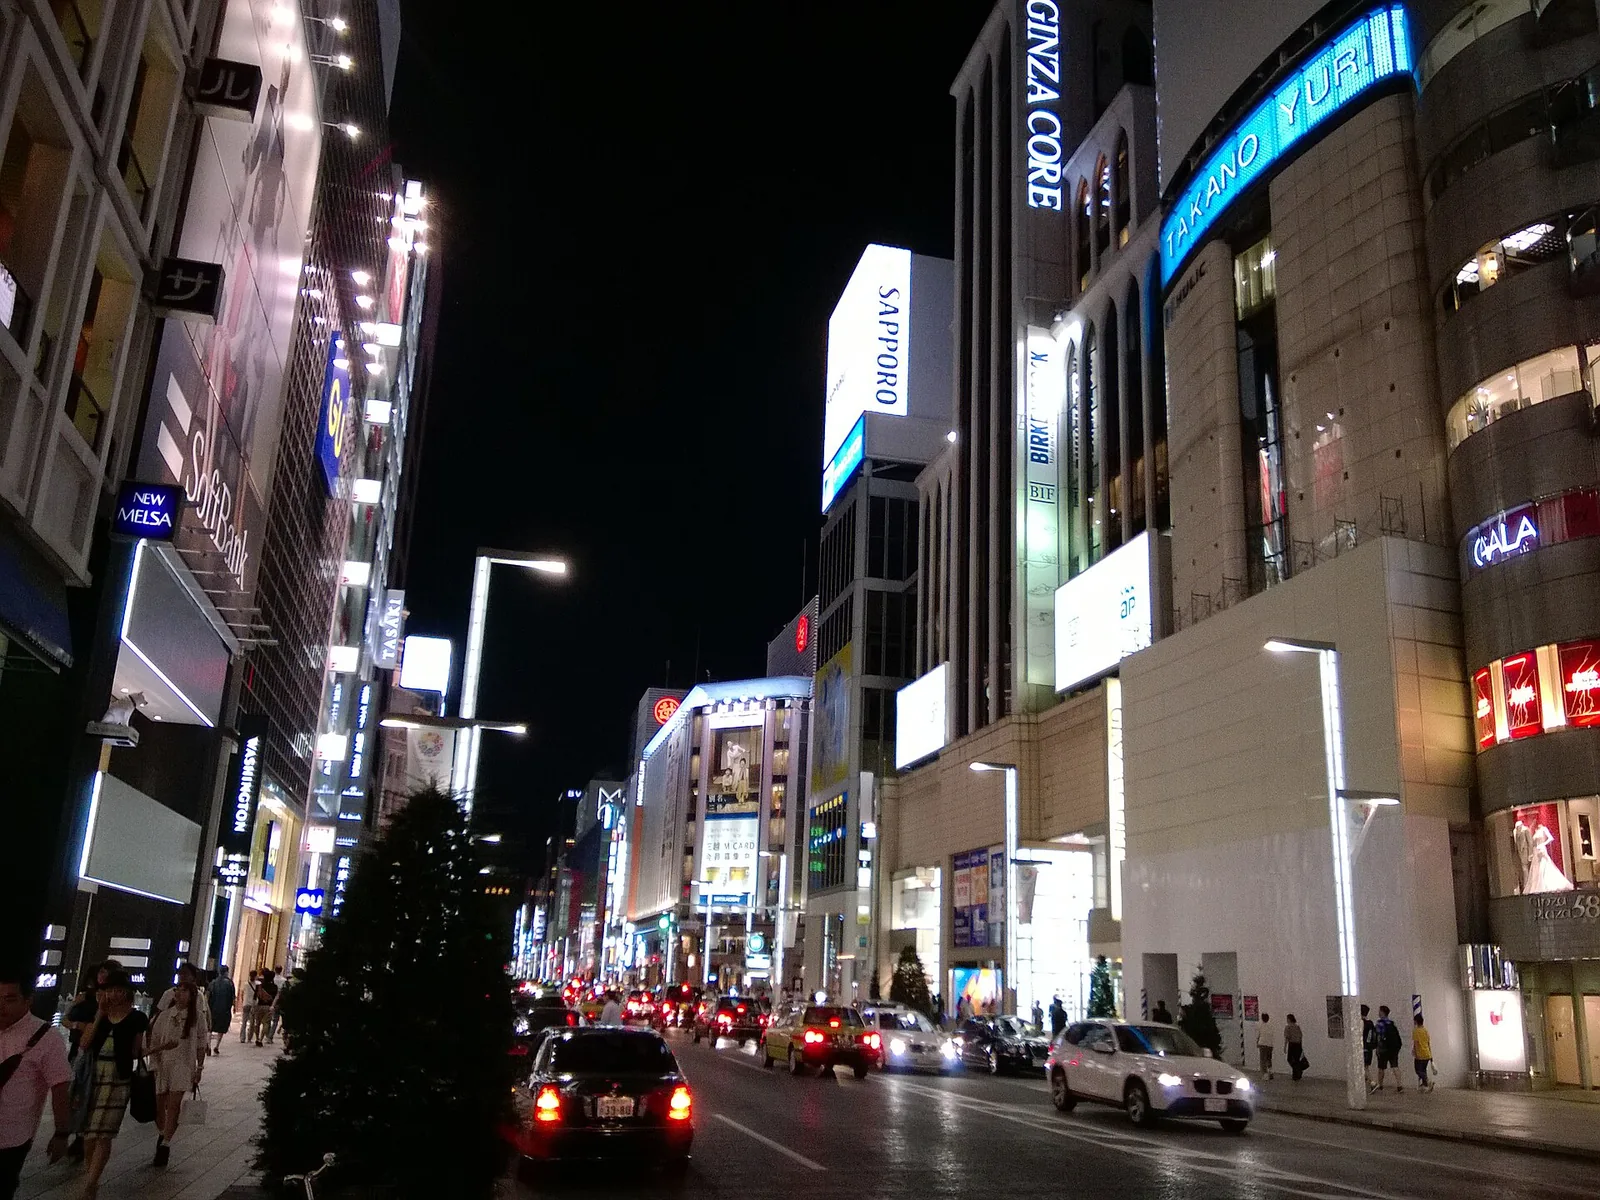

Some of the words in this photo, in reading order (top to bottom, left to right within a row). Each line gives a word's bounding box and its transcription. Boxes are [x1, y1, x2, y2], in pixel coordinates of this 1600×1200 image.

[1027, 0, 1060, 104] GINZA
[1027, 109, 1062, 211] CORE
[1166, 134, 1258, 257] TAKANO
[1281, 36, 1371, 125] YURI
[163, 267, 212, 301] サ
[875, 285, 900, 405] SAPPORO
[117, 507, 172, 528] MELSA
[132, 492, 166, 507] NEW
[185, 430, 249, 592] SoftBank
[1030, 485, 1055, 499] BIF
[382, 598, 401, 660] TASAKI
[233, 736, 260, 833] WASHINGTON
[1571, 894, 1600, 918] 58
